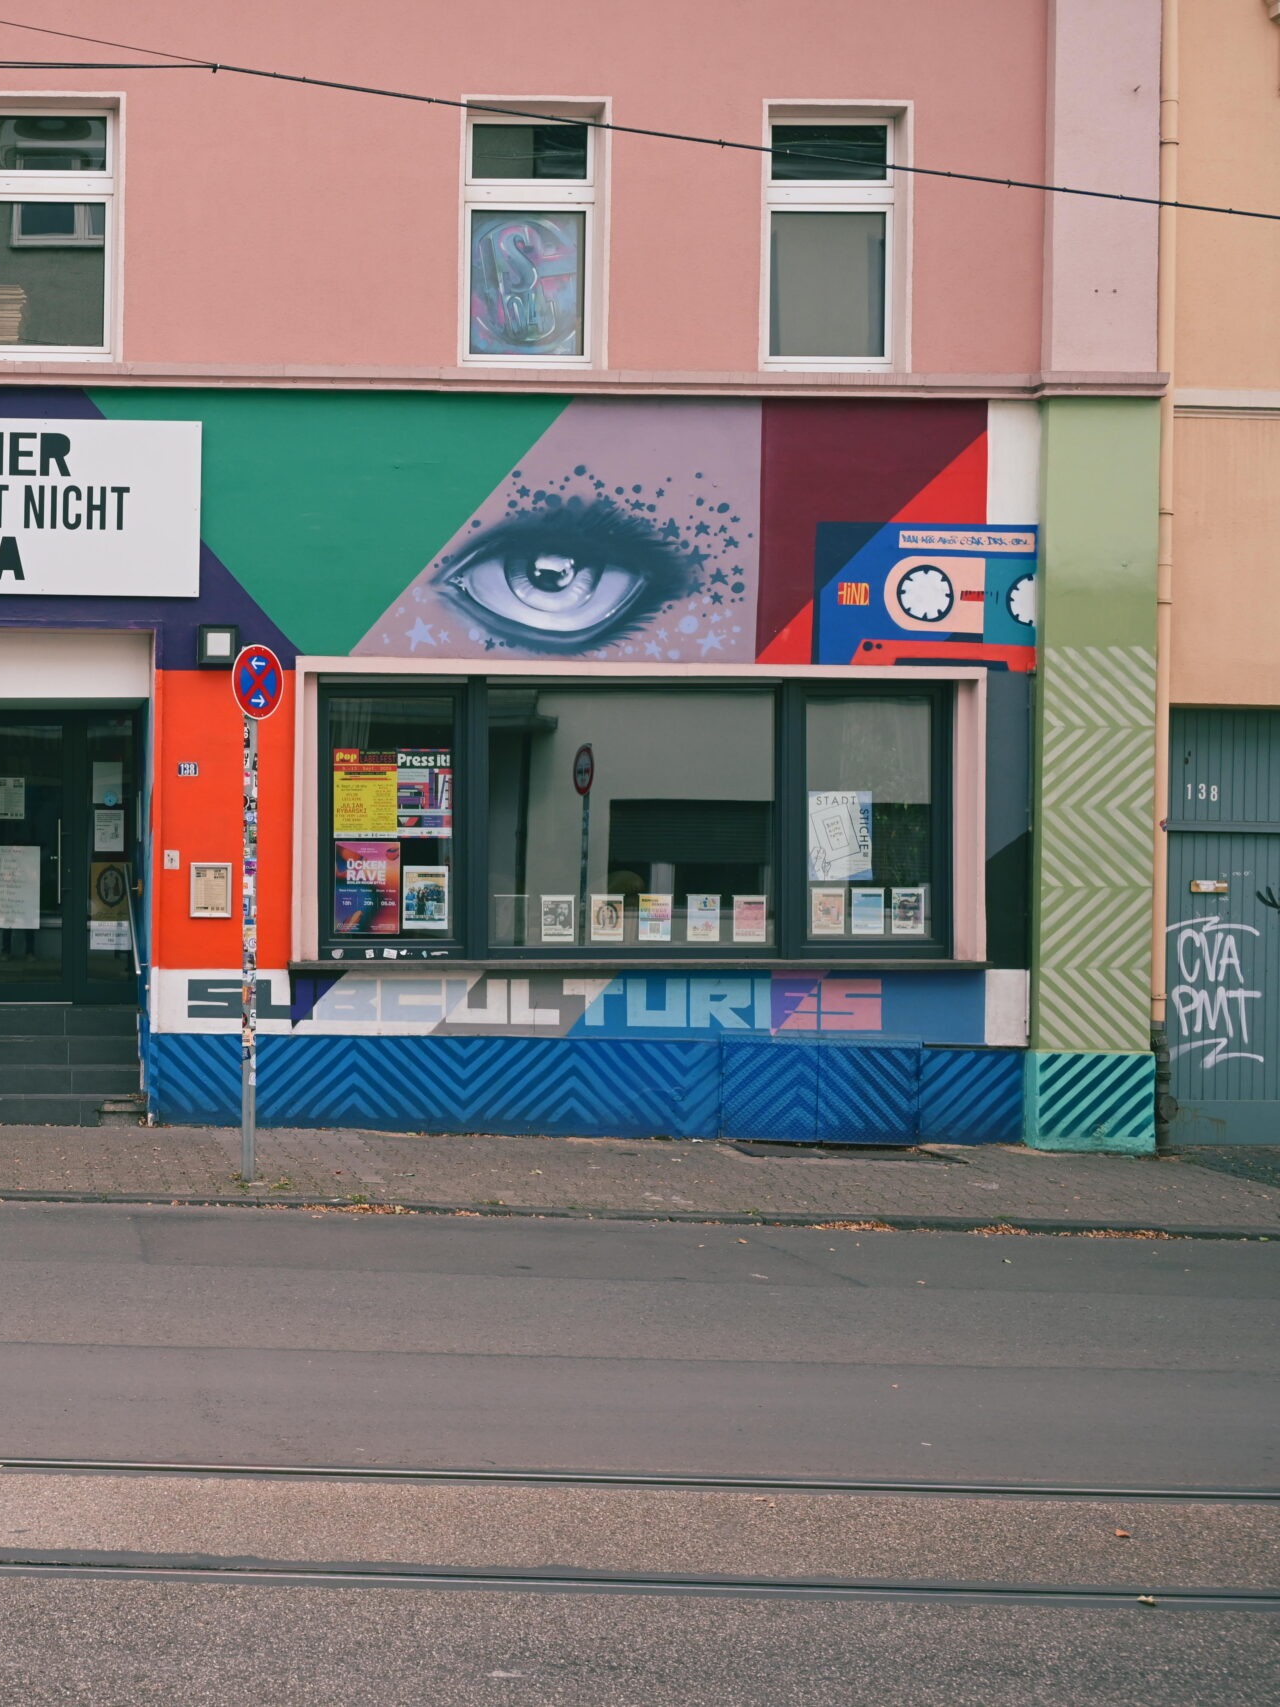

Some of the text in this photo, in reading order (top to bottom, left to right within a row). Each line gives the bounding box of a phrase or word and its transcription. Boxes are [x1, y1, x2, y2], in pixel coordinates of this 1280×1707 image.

[23, 484, 130, 530] NICHT
[336, 752, 357, 762] Pop
[397, 753, 450, 767] Press it!
[180, 763, 195, 774] 138
[1187, 783, 1218, 801] 138
[816, 796, 856, 806] STADT
[859, 808, 869, 850] STICHE
[346, 858, 386, 869] ÜCKEN
[346, 869, 386, 881] RAVE
[1177, 928, 1244, 983] CVA
[188, 978, 882, 1031] SUBCULTURES
[1171, 985, 1262, 1044] PMT
